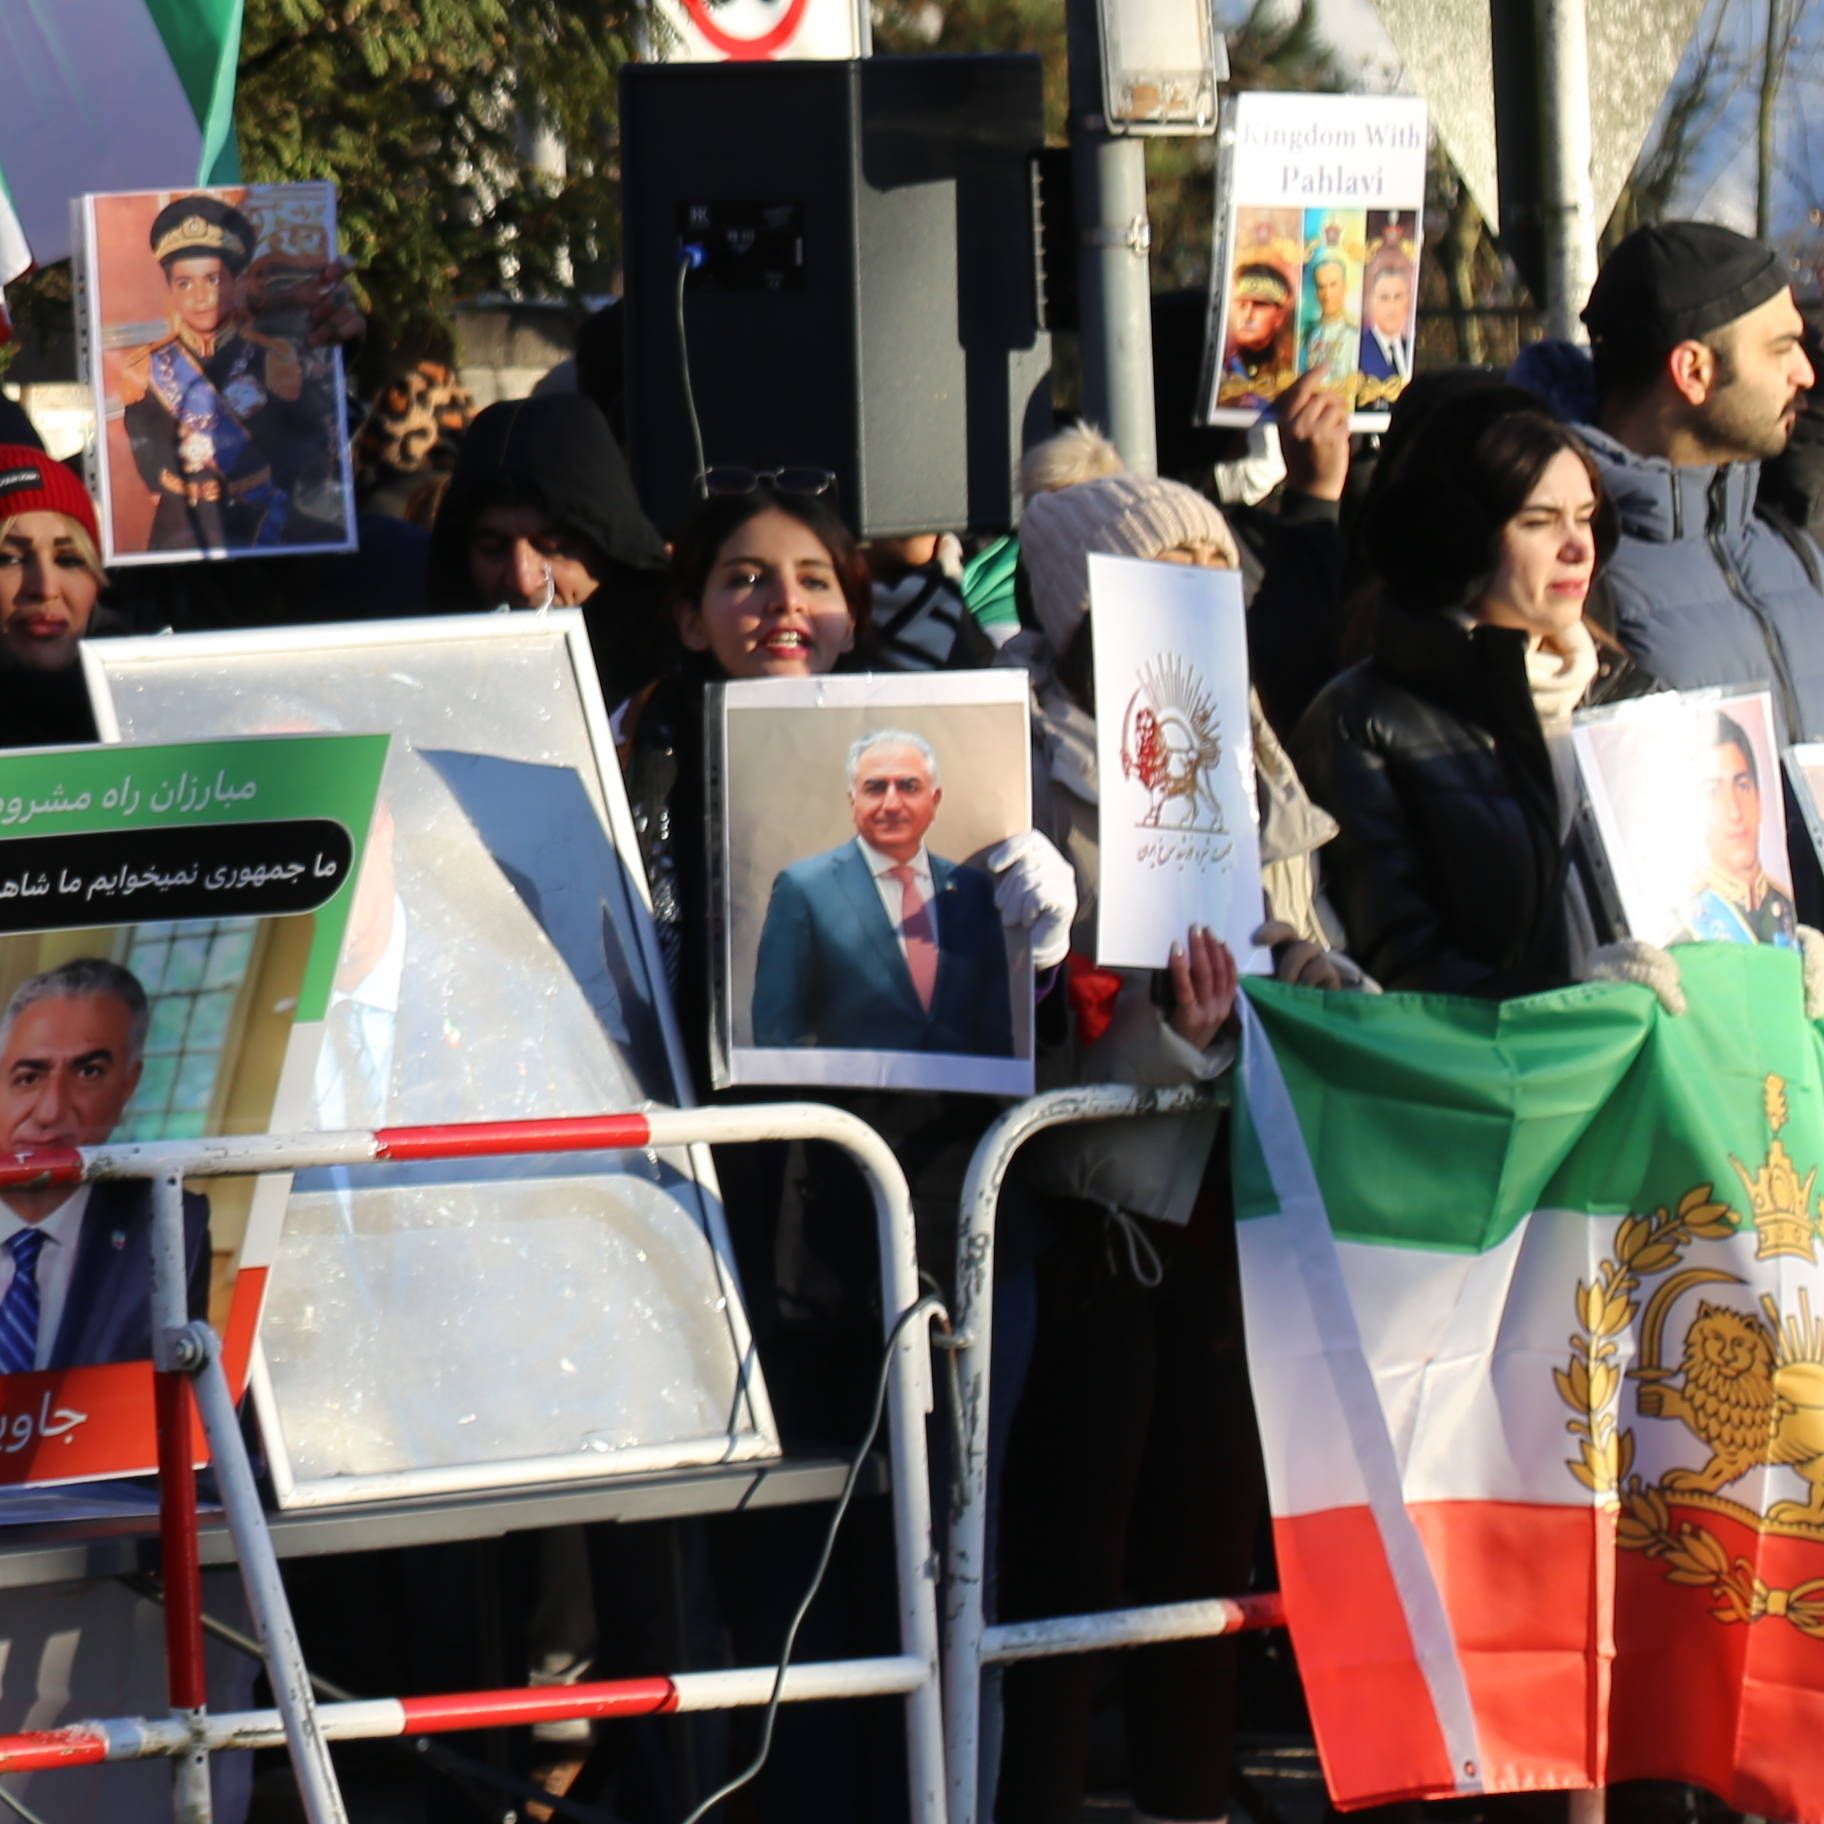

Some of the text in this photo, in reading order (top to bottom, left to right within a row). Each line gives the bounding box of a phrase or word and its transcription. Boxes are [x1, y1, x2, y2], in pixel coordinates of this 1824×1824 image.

[1244, 121, 1421, 152] Kingdom With
[1281, 163, 1384, 196] Pahlavi
[101, 775, 140, 816] راه
[149, 770, 257, 812] مبارزان
[204, 860, 306, 890] جمهوری
[313, 852, 337, 878] ما
[58, 869, 82, 894] ما
[86, 862, 199, 902] نمیخوایم
